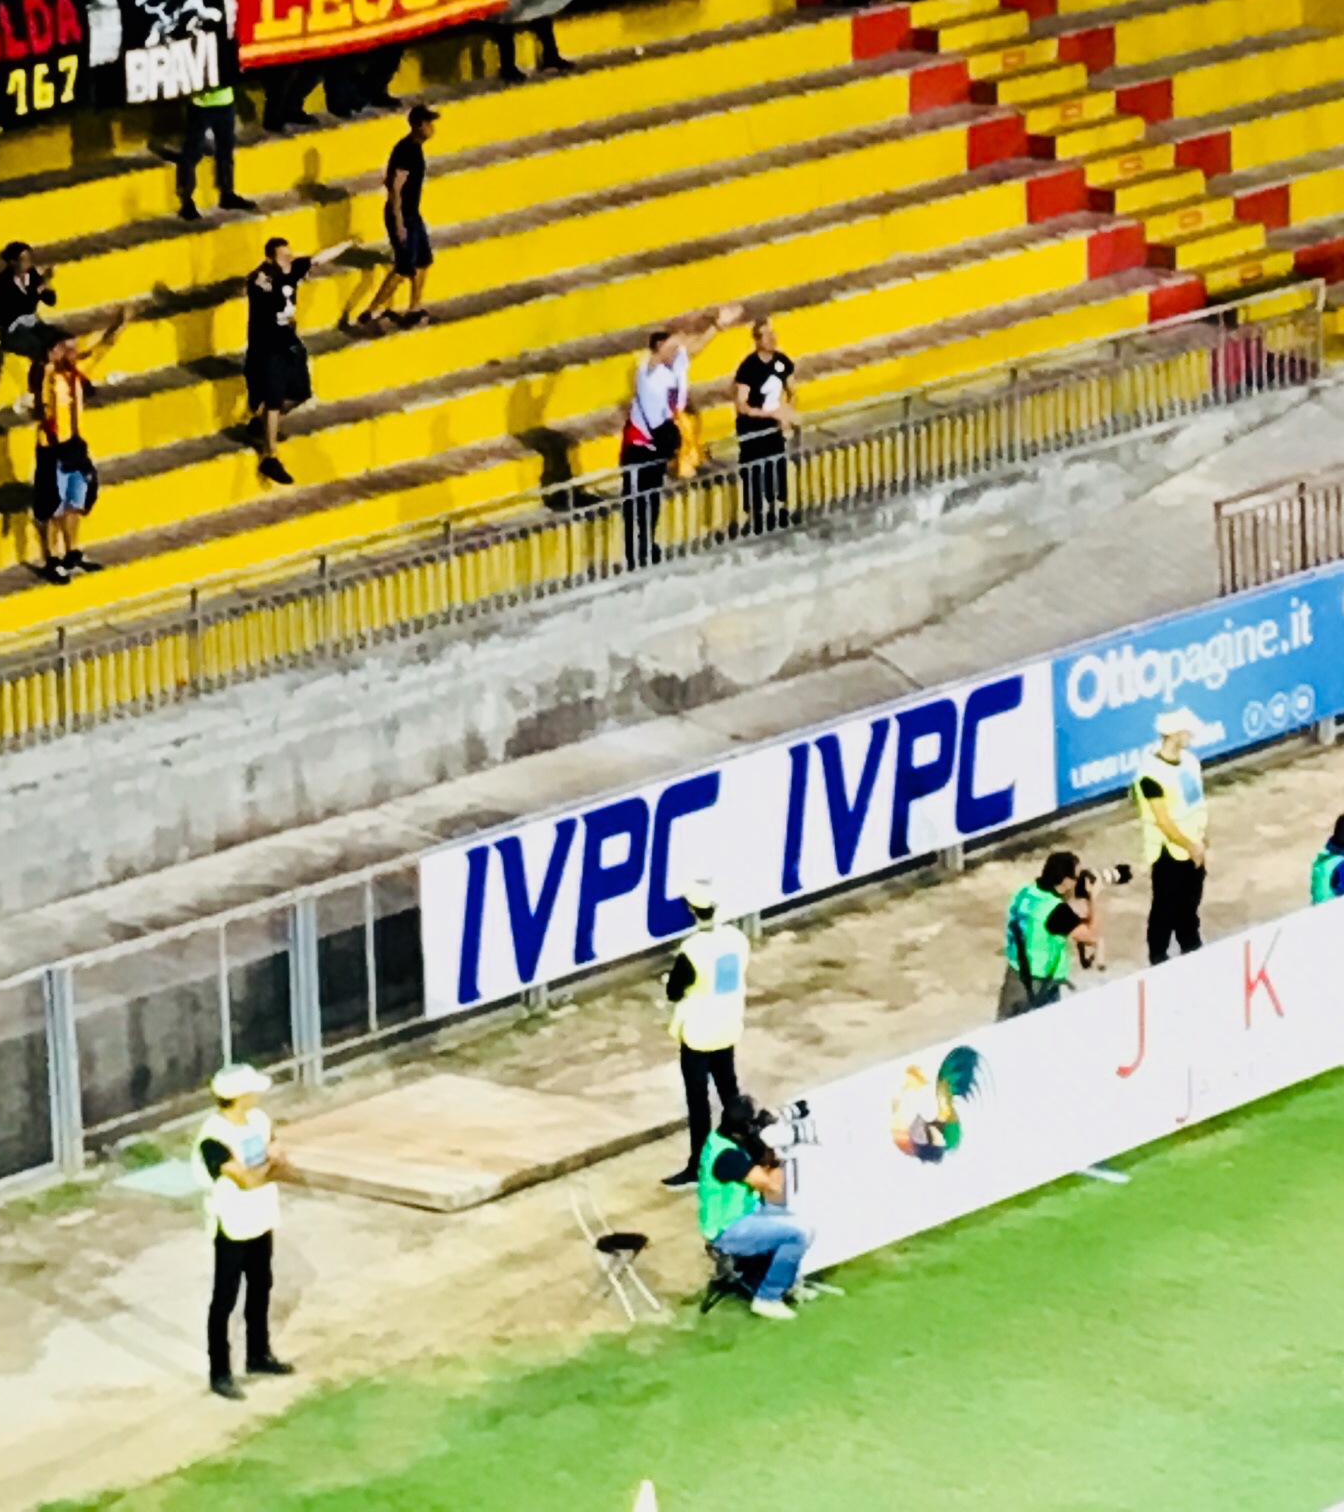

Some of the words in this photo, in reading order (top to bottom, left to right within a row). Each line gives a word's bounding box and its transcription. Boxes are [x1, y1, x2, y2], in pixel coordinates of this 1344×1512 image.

[6, 54, 79, 116] 167
[1066, 596, 1314, 719] Ottopagine.it
[781, 674, 1023, 895] IVPC
[457, 770, 722, 1005] IVPC
